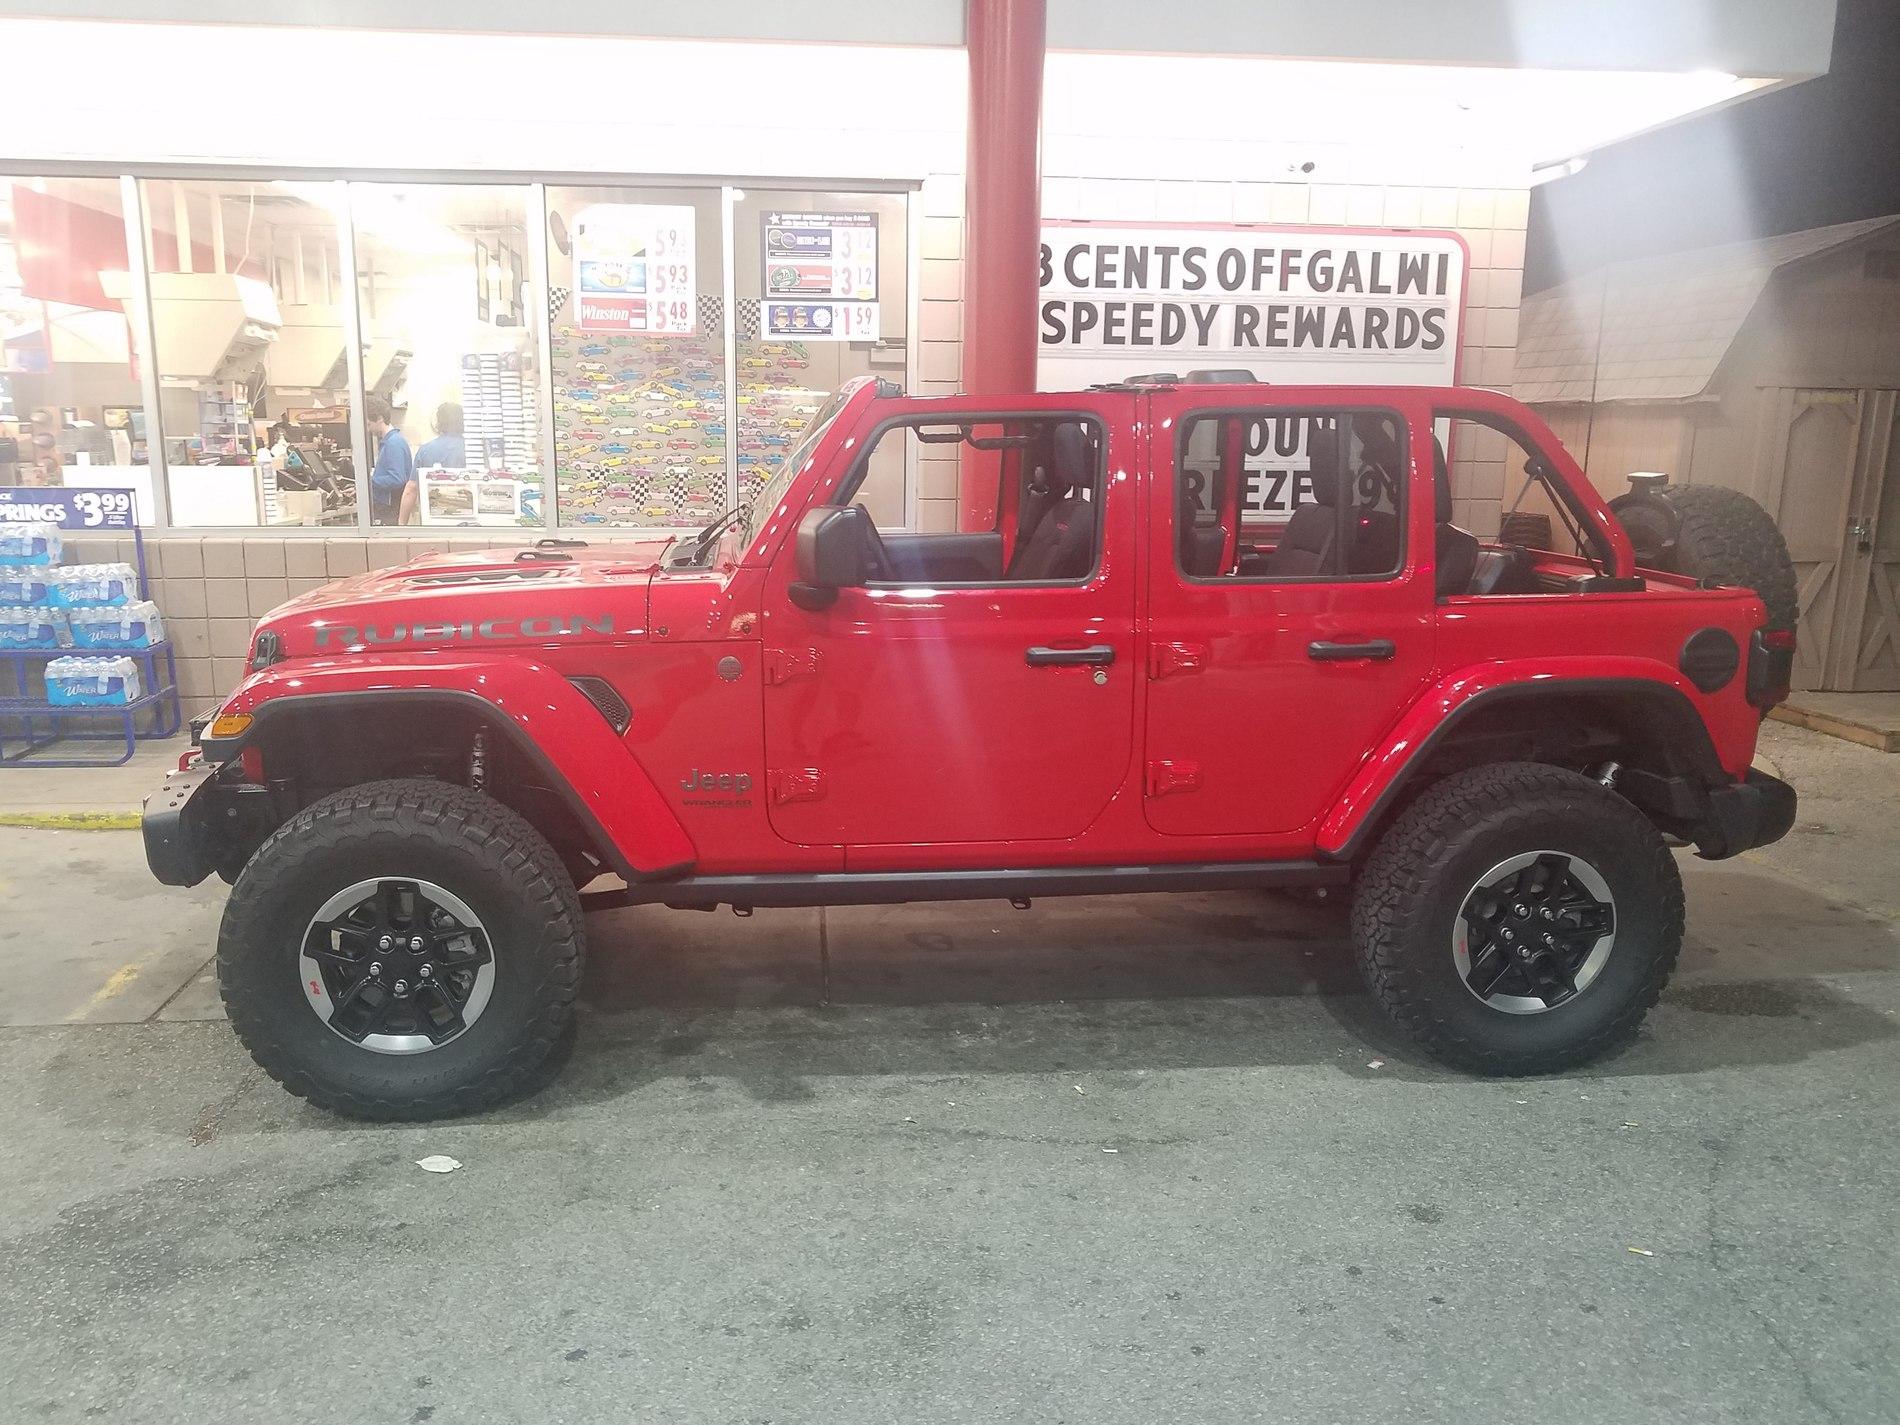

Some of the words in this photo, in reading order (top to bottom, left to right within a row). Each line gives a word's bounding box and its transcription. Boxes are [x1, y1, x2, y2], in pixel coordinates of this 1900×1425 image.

[1064, 244, 1207, 290] CENTS
[582, 304, 630, 320] Winston
[1041, 300, 1220, 346] SPEEDY
[1233, 304, 1446, 350] REWARDS
[313, 613, 616, 646] RUBICON
[681, 768, 752, 795] Jeep
